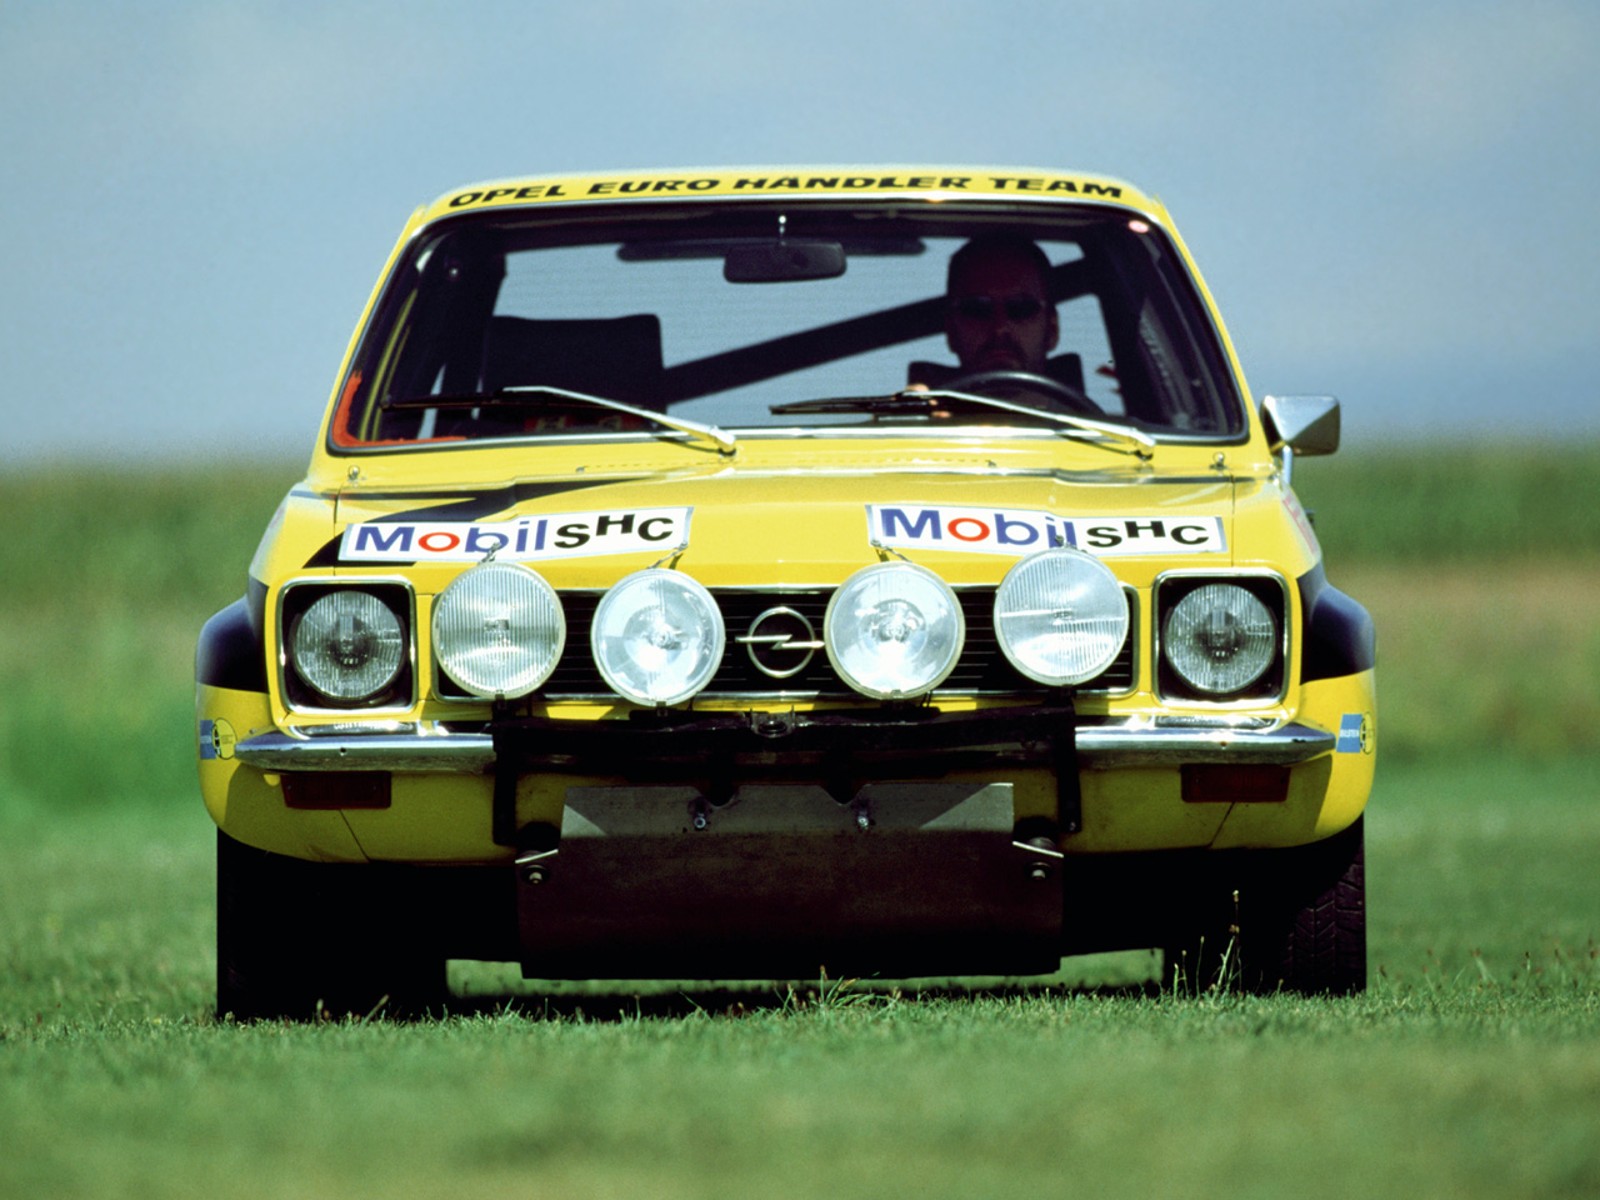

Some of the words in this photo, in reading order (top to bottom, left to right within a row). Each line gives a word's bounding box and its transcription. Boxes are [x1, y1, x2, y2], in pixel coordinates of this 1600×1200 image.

[449, 185, 567, 208] OPEL
[586, 178, 721, 195] EURO
[989, 178, 1122, 198] TEAM
[354, 519, 548, 553] Mobil
[554, 514, 674, 549] SHC
[880, 508, 1077, 548] Mobil
[1086, 520, 1209, 548] SHC
